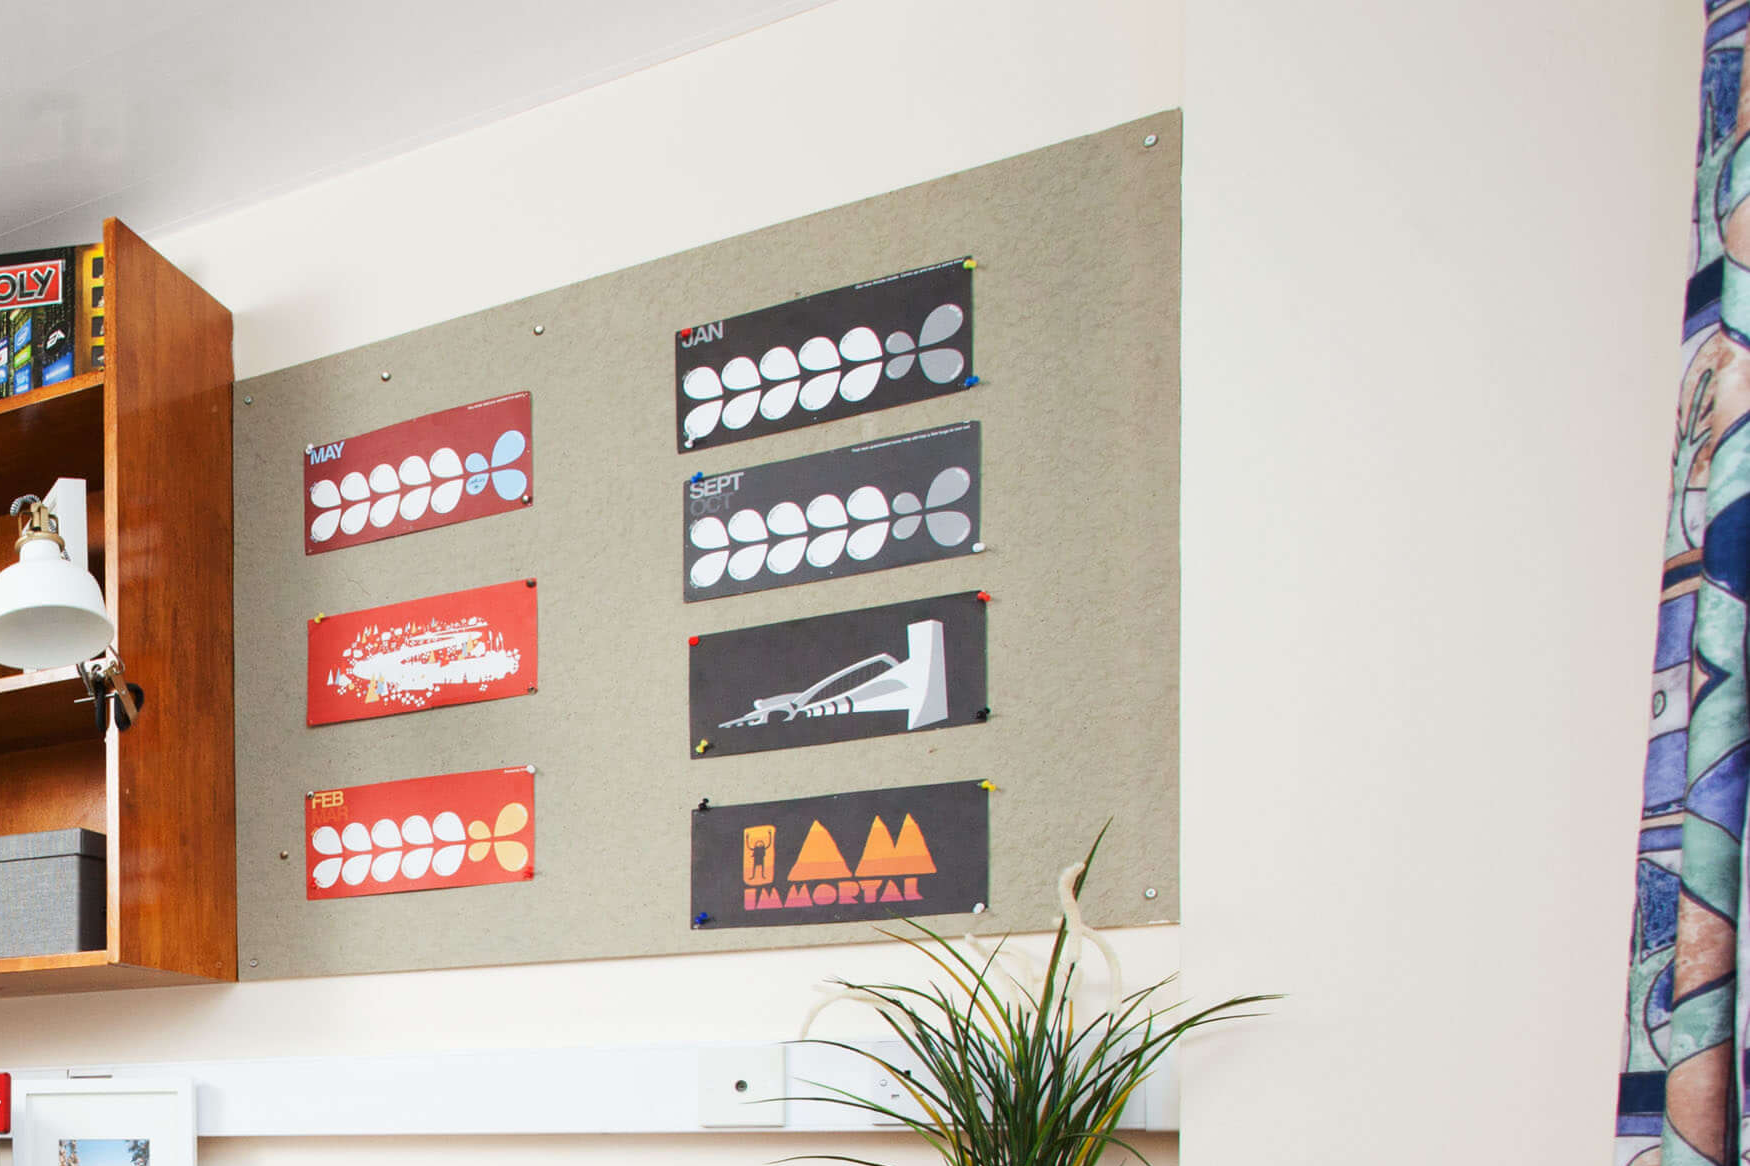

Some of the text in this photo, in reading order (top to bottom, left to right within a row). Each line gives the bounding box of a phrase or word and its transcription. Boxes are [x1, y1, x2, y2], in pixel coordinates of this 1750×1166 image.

[682, 320, 722, 349] JAN
[310, 441, 345, 465] MAY
[690, 472, 744, 499] SEPT
[690, 492, 735, 515] OCT
[312, 790, 344, 809] FEB
[744, 877, 924, 911] IMMORTAL
